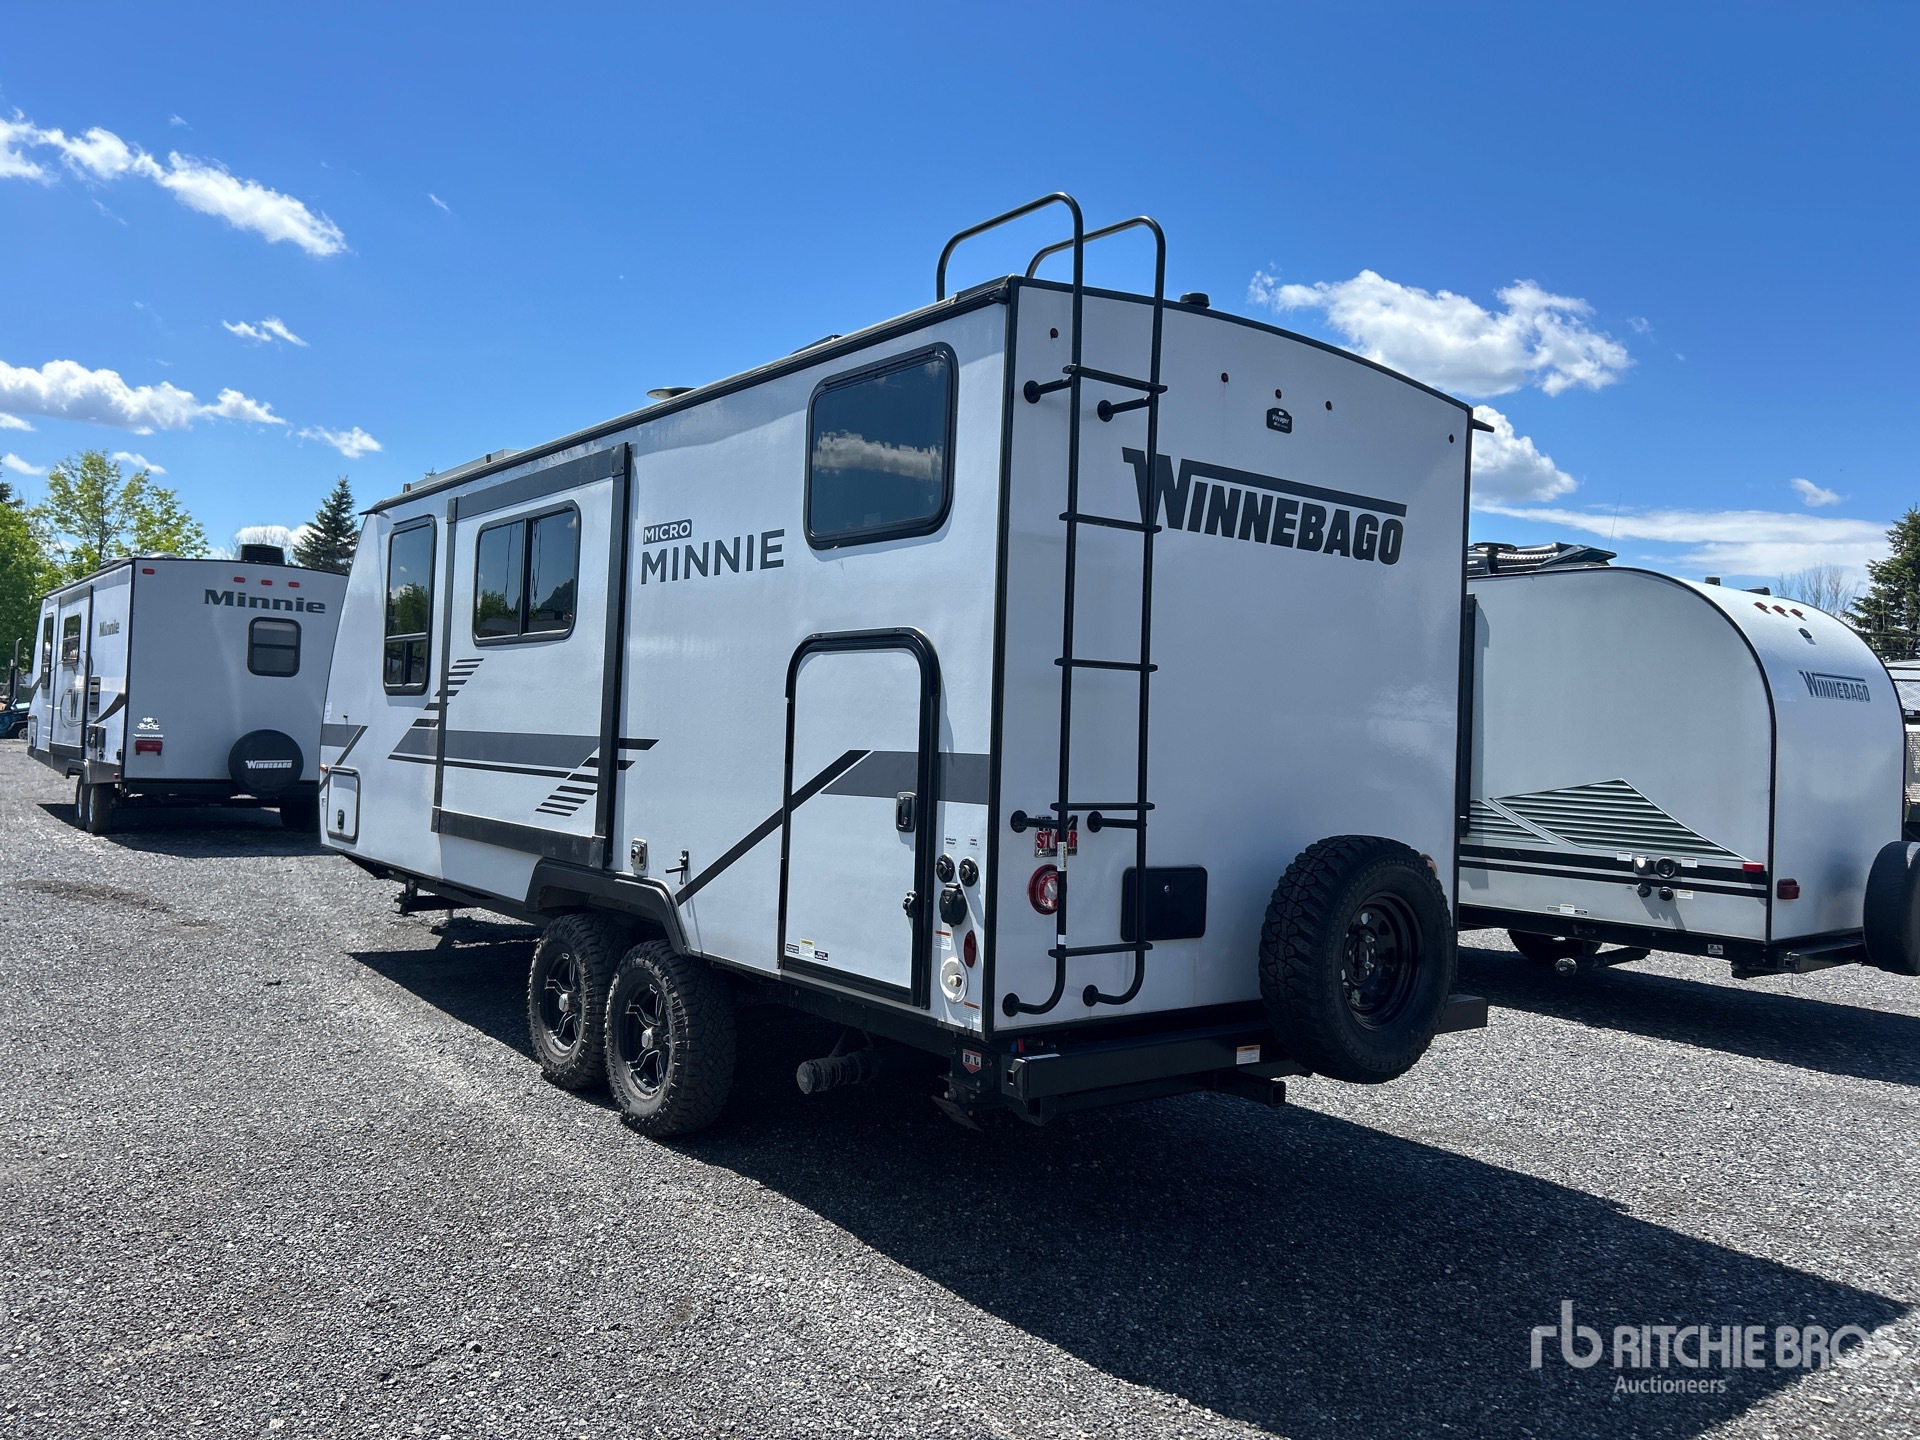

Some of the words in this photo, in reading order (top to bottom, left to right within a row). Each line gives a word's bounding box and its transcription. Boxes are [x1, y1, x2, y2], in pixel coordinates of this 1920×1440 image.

[1121, 446, 1407, 565] WINNEBAGO
[644, 522, 691, 543] MICRO
[641, 528, 785, 585] MINNIE
[204, 589, 326, 614] Minnie
[1797, 669, 1871, 702] WINNEBAGO
[245, 760, 292, 769] WINNEBAGO
